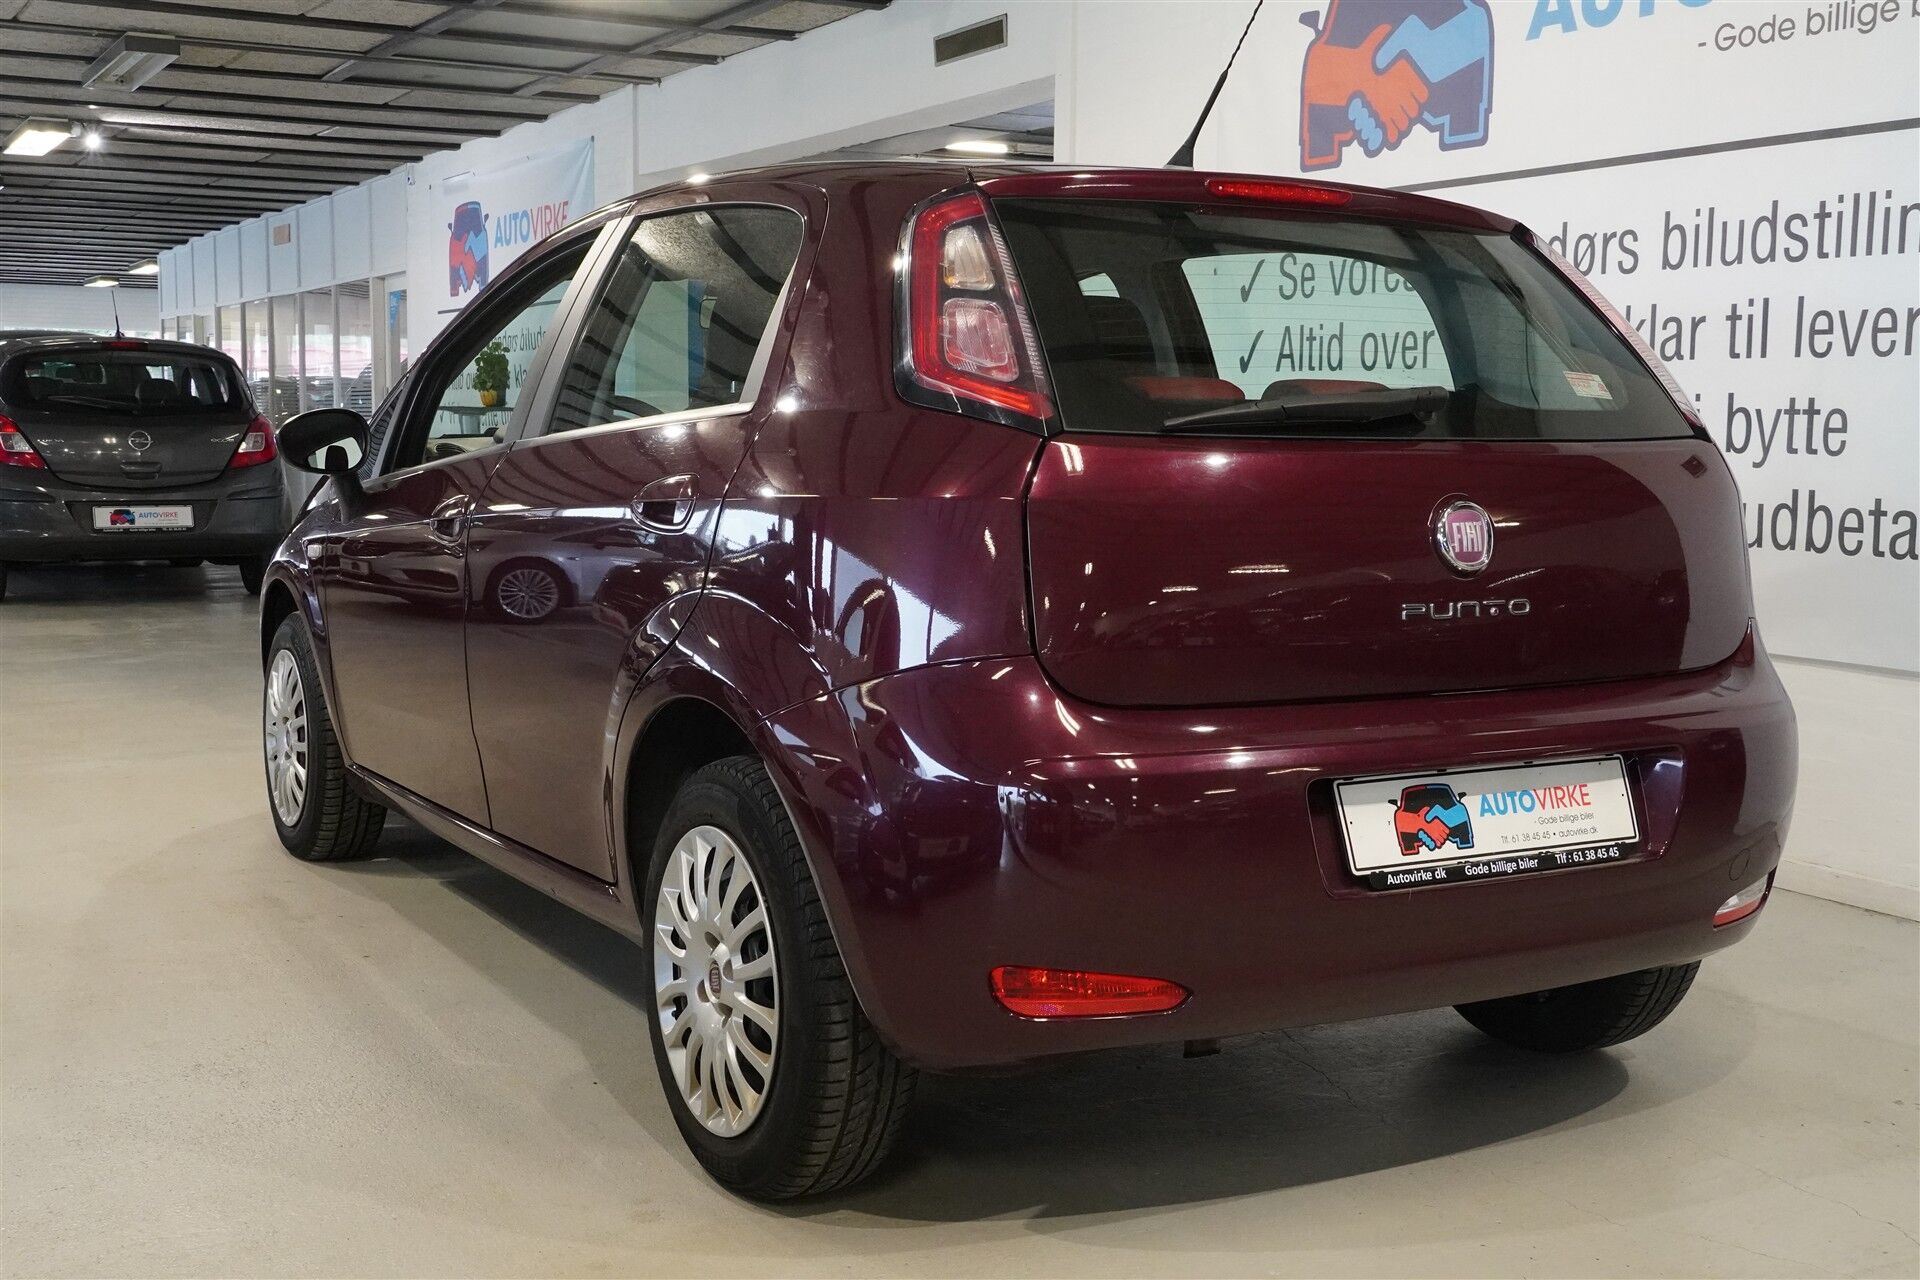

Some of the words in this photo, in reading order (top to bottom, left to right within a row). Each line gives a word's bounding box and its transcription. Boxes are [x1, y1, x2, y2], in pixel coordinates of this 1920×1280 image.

[1713, 14, 1796, 51] Gode
[1806, 0, 1900, 36] billige
[494, 200, 569, 248] AUTOVIRKE
[1278, 253, 1316, 300] Se
[1275, 322, 1345, 372] Altid
[1360, 329, 1435, 371] over
[1725, 297, 1770, 359] til
[1724, 393, 1848, 469] bytte
[1452, 521, 1482, 552] FIAT
[1401, 599, 1530, 620] PUNTO
[1480, 783, 1591, 817] AUTOVIRKE
[1538, 816, 1557, 825] Gode
[1559, 814, 1579, 823] billige
[1580, 812, 1594, 821] biler
[1512, 835, 1519, 843] 61
[1522, 833, 1531, 842] 38
[1532, 832, 1541, 841] 45
[1542, 831, 1551, 840] 45
[1387, 869, 1433, 885] Autovirke
[1435, 868, 1447, 879] dk
[1465, 864, 1489, 876] Gode
[1491, 858, 1517, 873] billige
[1518, 857, 1538, 869] biler
[1555, 852, 1567, 864] Tlf
[1573, 851, 1583, 862] 61
[1585, 849, 1596, 860] 38
[1597, 848, 1607, 859] 45
[1609, 846, 1619, 857] 45
